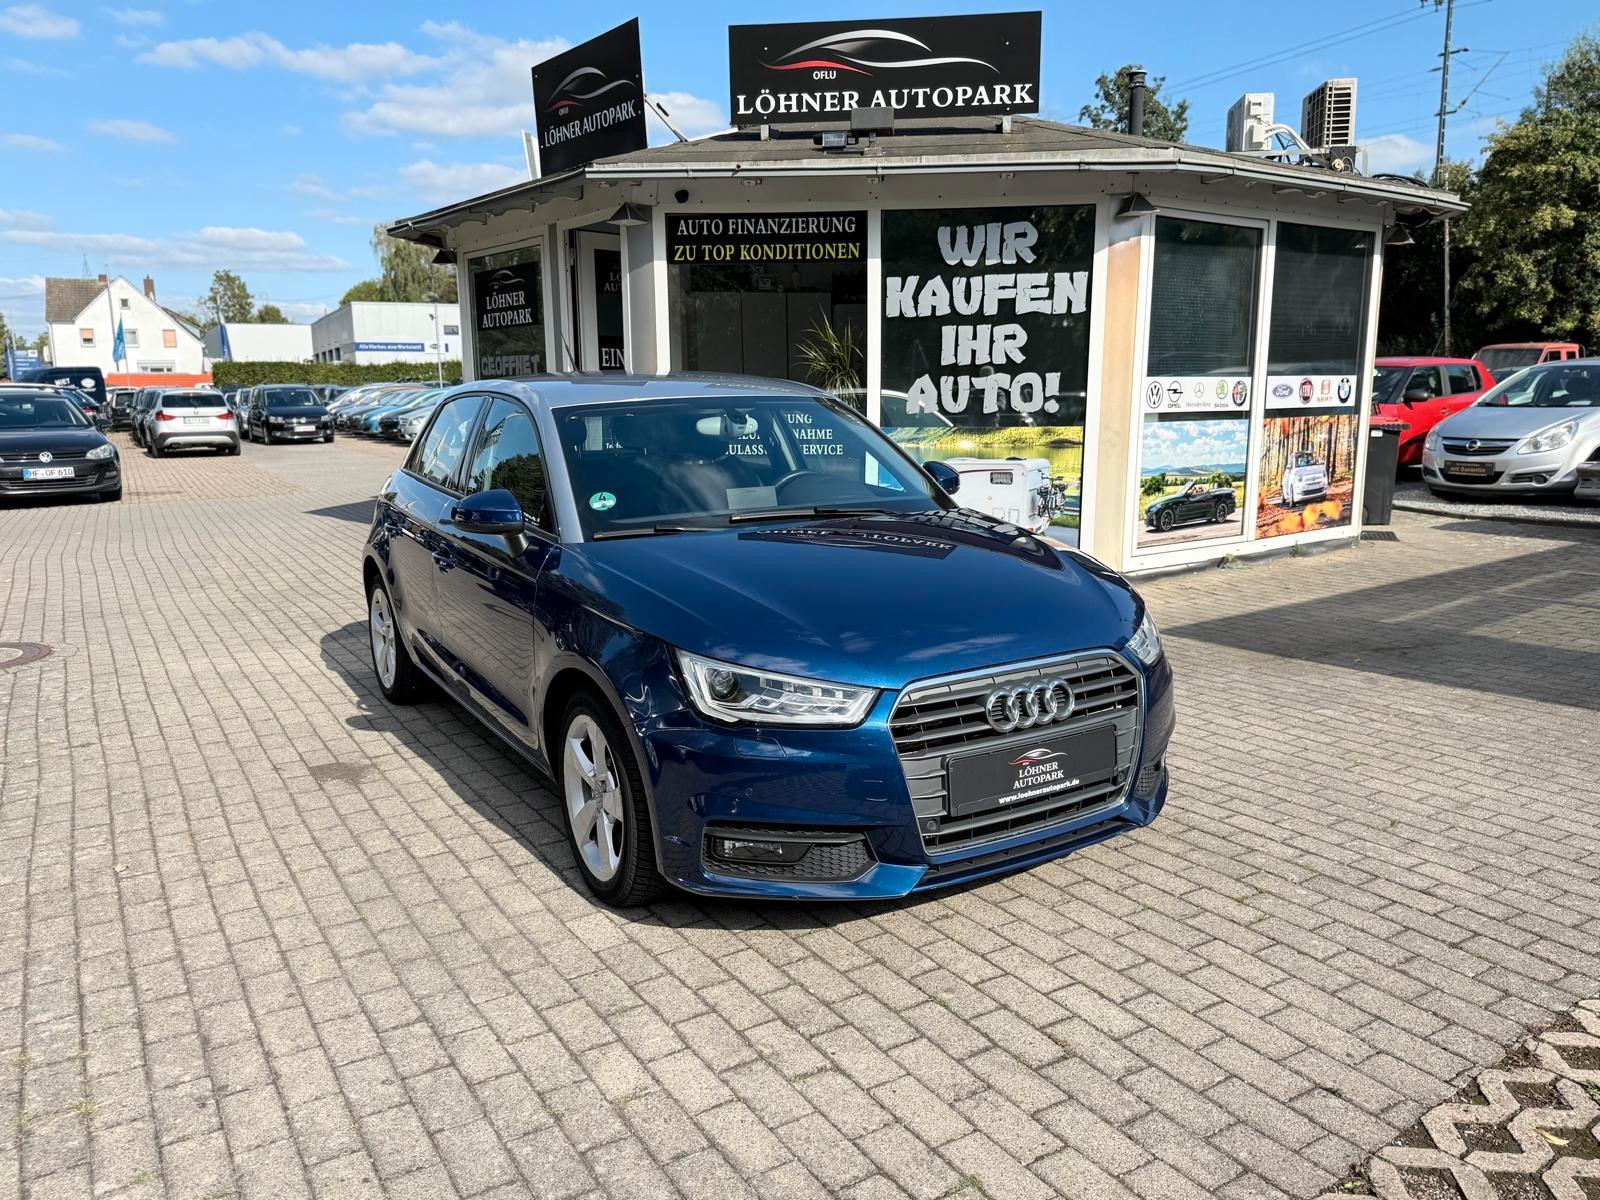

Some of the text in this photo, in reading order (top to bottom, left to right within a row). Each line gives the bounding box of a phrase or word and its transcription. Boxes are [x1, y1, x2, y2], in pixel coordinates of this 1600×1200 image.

[813, 70, 837, 80] OFLU
[736, 83, 1035, 115] LÖHNER AUTOPARK
[544, 99, 636, 148] LÖHNER AUTOPARK
[677, 216, 856, 235] AUTO FINANZIERUNG
[674, 242, 861, 261] ZU TOP KONDITIONEN
[937, 221, 1039, 267] WIR
[486, 290, 526, 311] LÖHNER
[885, 271, 1089, 318] KAUFEN
[482, 308, 533, 329] AUTOPARK
[940, 323, 1028, 367] IHR
[481, 351, 540, 377] GEÖFFNET
[905, 371, 1061, 415] AUTO!
[800, 444, 843, 456] ERVICE
[598, 492, 607, 502] 4
[1012, 769, 1065, 790] AUTOPARK
[1018, 761, 1059, 778] LÖHNER
[998, 778, 1080, 805] www.loehnerautopark.de
